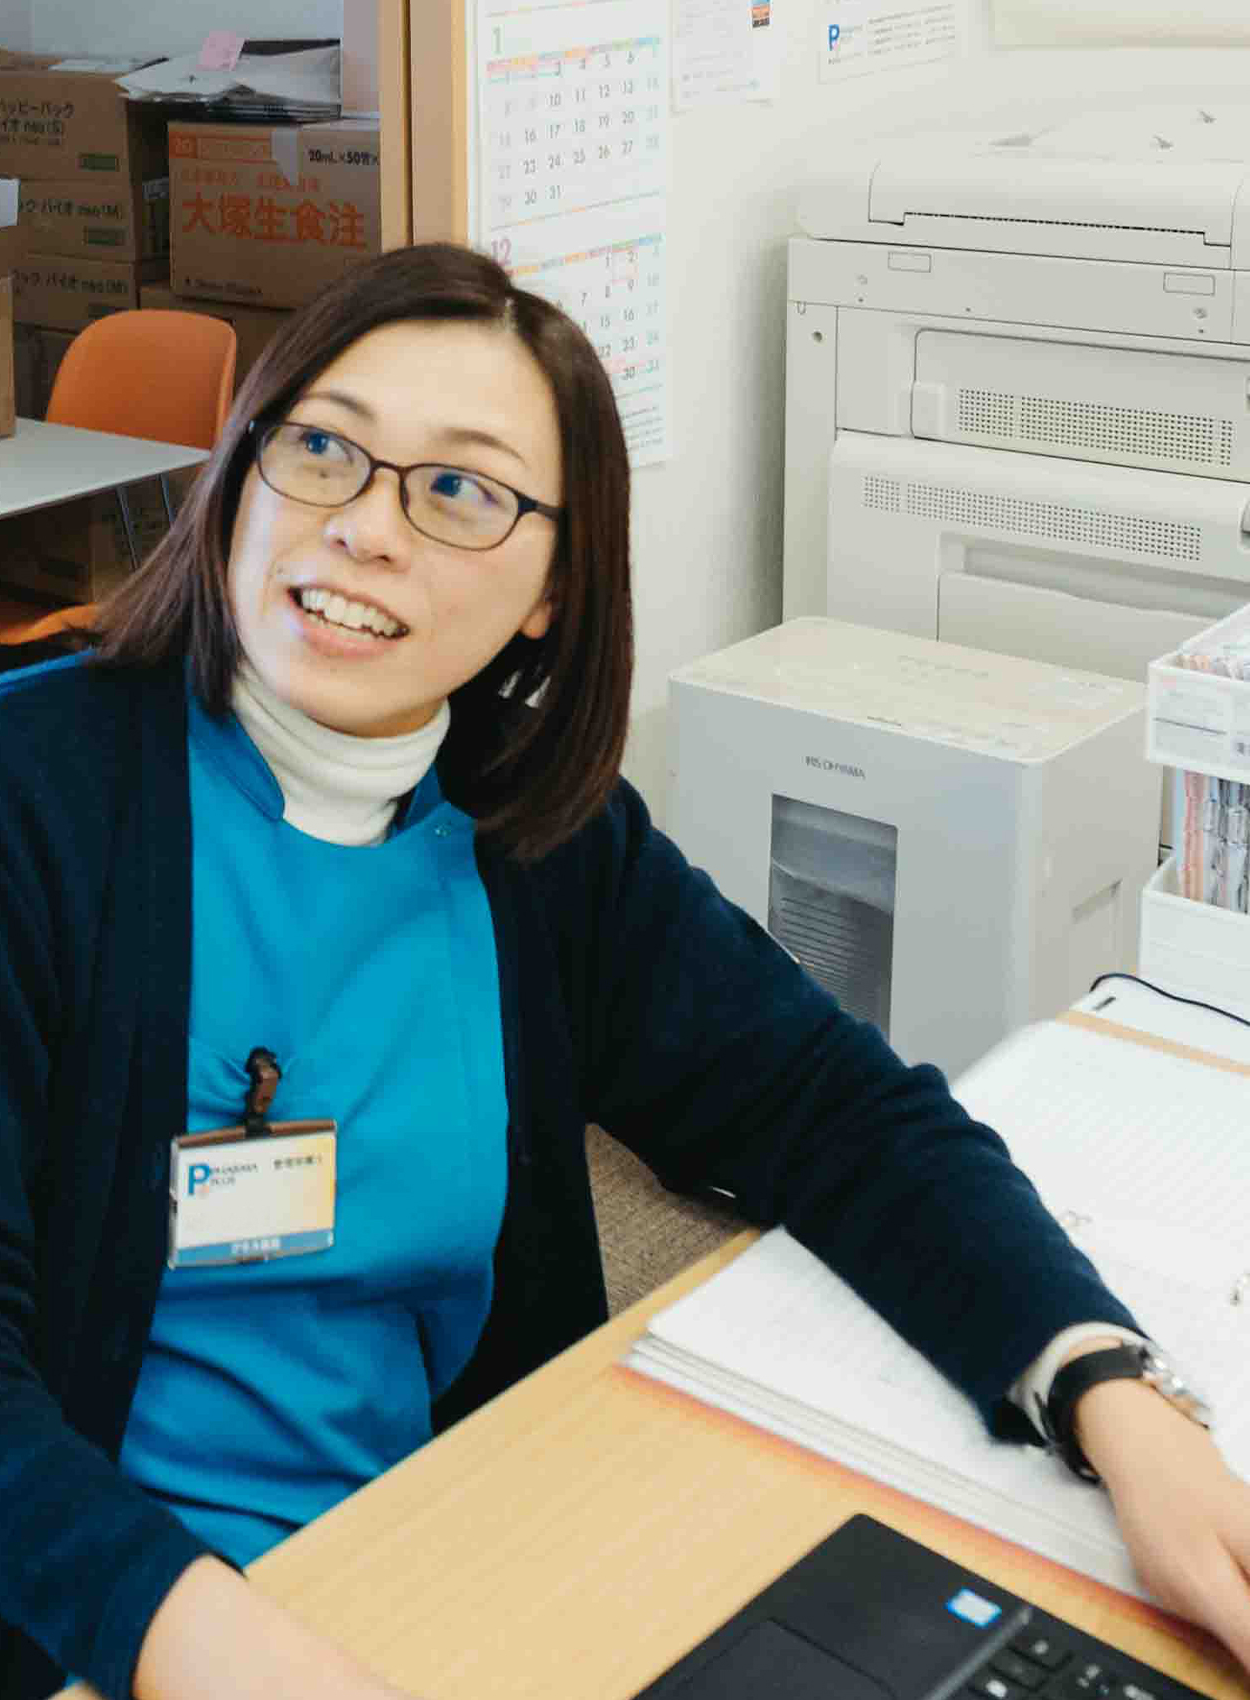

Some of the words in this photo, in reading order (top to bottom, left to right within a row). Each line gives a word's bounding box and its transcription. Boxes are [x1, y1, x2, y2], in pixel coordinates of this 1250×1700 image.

[549, 93, 562, 107] 10
[574, 89, 587, 104] 11
[599, 85, 612, 98] 12
[524, 128, 537, 145] 16
[549, 124, 562, 139] 17
[574, 119, 586, 133] 18
[599, 115, 611, 129] 19
[621, 111, 635, 125] 20
[524, 159, 537, 175] 23
[547, 153, 561, 169] 24
[573, 149, 586, 165] 25
[598, 145, 611, 159] 26
[621, 139, 634, 155] 27
[524, 189, 537, 205] 30
[548, 185, 561, 200] 31
[181, 190, 367, 248] 大塚生食注
[491, 238, 512, 265] 12
[605, 252, 611, 268] 1
[625, 249, 634, 263] 2
[580, 291, 588, 307] 7
[626, 279, 635, 293] 9
[599, 314, 611, 328] 15
[623, 308, 635, 322] 16
[622, 337, 636, 352] 23
[621, 366, 636, 380] 30
[187, 1163, 210, 1196] P
